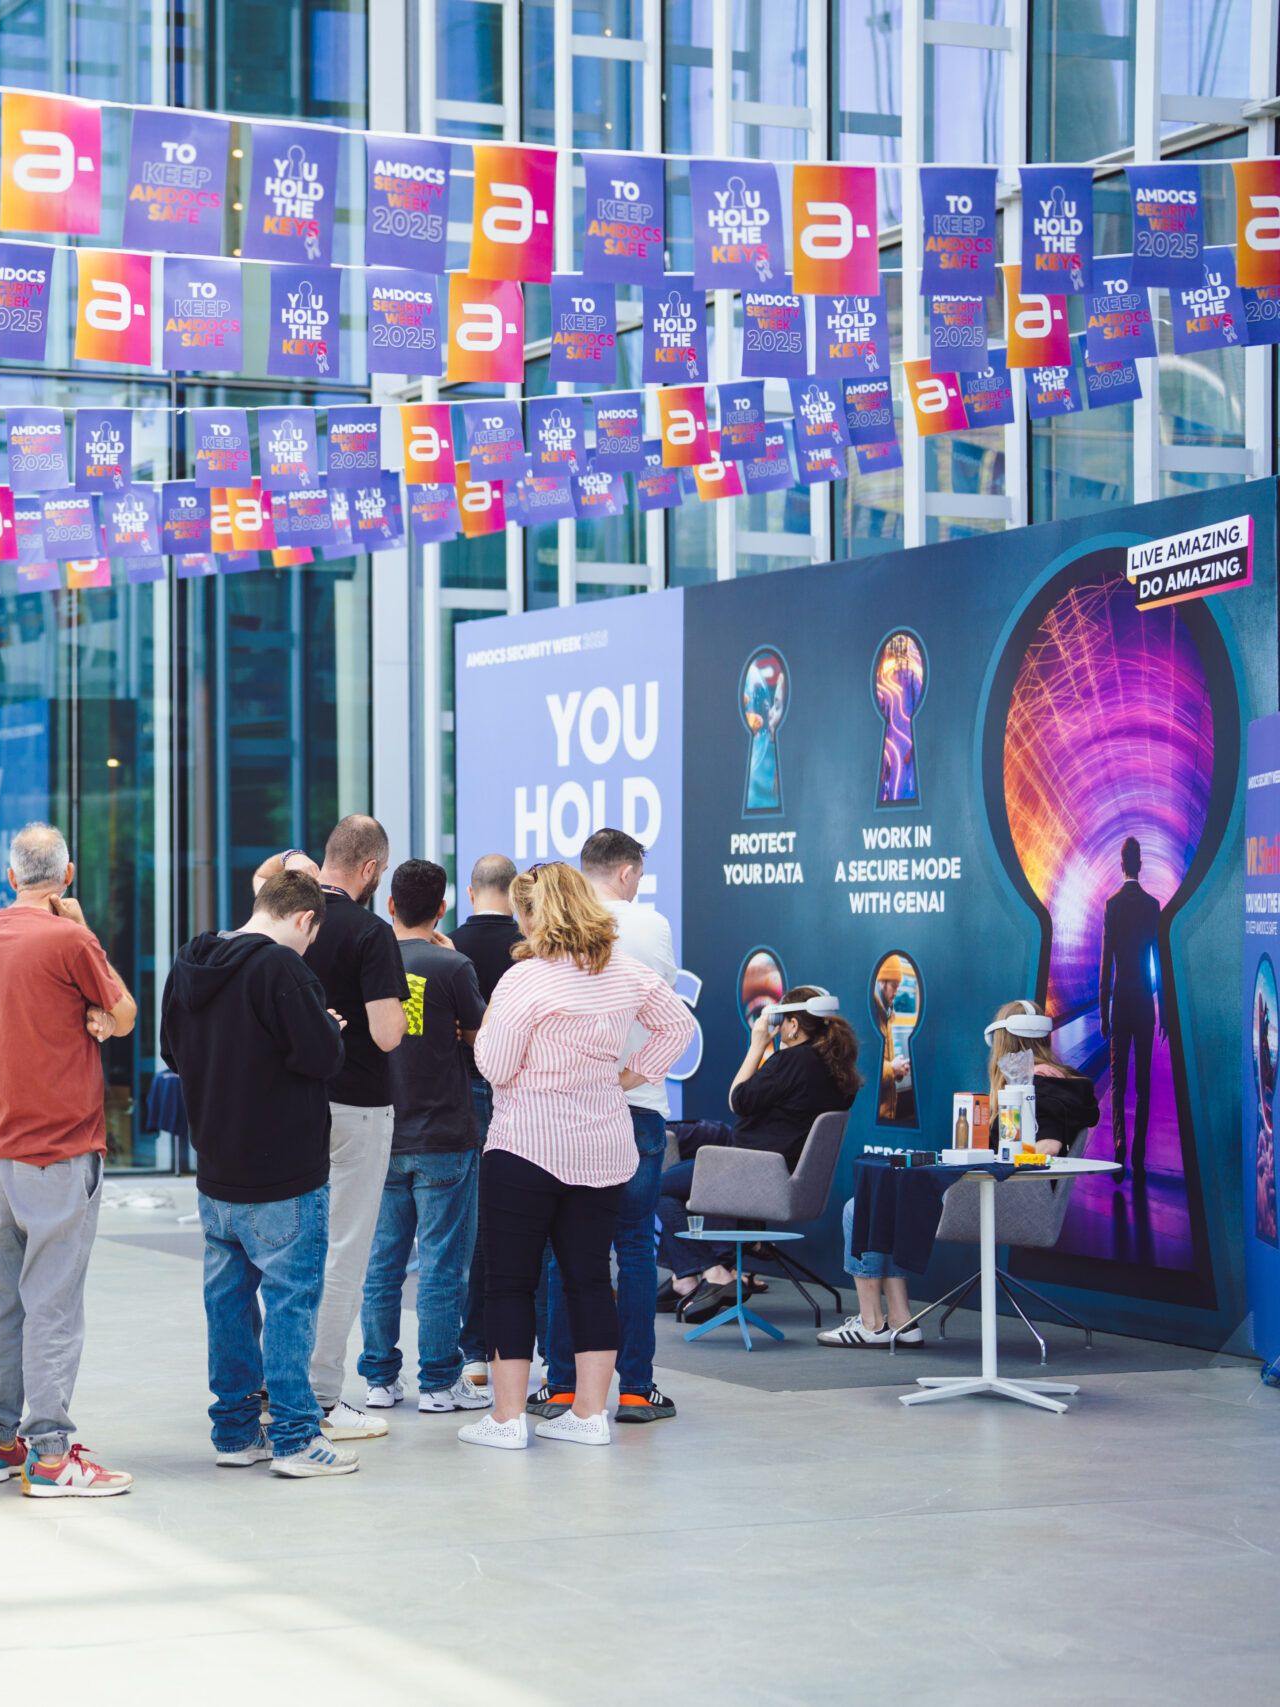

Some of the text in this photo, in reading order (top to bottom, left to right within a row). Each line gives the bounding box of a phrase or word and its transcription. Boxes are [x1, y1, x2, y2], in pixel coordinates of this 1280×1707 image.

[266, 177, 323, 201] HOLD
[611, 180, 638, 200] TO
[1136, 187, 1196, 205] AMDOCS
[272, 197, 313, 219] THE
[597, 198, 652, 226] KEEP
[1136, 203, 1196, 219] SECURITY
[265, 215, 319, 239] KEYS
[589, 219, 662, 245] AMDOCS
[1035, 219, 1082, 235] HOLD
[1148, 217, 1184, 232] WEEK
[604, 238, 646, 258] SAFE
[1042, 236, 1075, 253] THE
[1138, 230, 1198, 259] 2025
[1037, 253, 1080, 270] KEYS
[373, 287, 432, 304] AMDOCS
[373, 299, 432, 316] SECURITY
[385, 312, 421, 326] WEEK
[373, 323, 436, 350] 2025
[846, 382, 888, 394] AMDOCS
[734, 398, 749, 409] TO
[847, 391, 888, 403] SECURITY
[855, 401, 881, 410] WEEK
[848, 409, 891, 427] 2025
[11, 425, 60, 434] AMDOCS
[211, 424, 230, 435] TO
[539, 429, 576, 439] HOLD
[722, 423, 764, 434] AMDOCS
[11, 435, 60, 444] SECURITY
[202, 435, 241, 450] KEEP
[545, 440, 571, 450] THE
[731, 434, 755, 444] SAFE
[21, 444, 51, 453] WEEK
[197, 449, 249, 461] AMDOCS
[542, 451, 576, 461] KEYS
[11, 453, 63, 471] 2025
[208, 460, 238, 471] SAFE
[1131, 525, 1243, 570] LIVE AMAZING.
[1140, 556, 1243, 599] DO AMAZING.
[466, 647, 506, 668] AMDOCS
[507, 640, 551, 662] SECURITY
[552, 635, 581, 655] WEEK
[546, 681, 659, 767] YOU
[730, 831, 797, 855] PROTECT
[862, 825, 932, 850] WORK IN
[723, 862, 804, 885] YOUR DATA
[834, 857, 961, 882] A SECURE MODE
[849, 890, 945, 914] WITH GENAI
